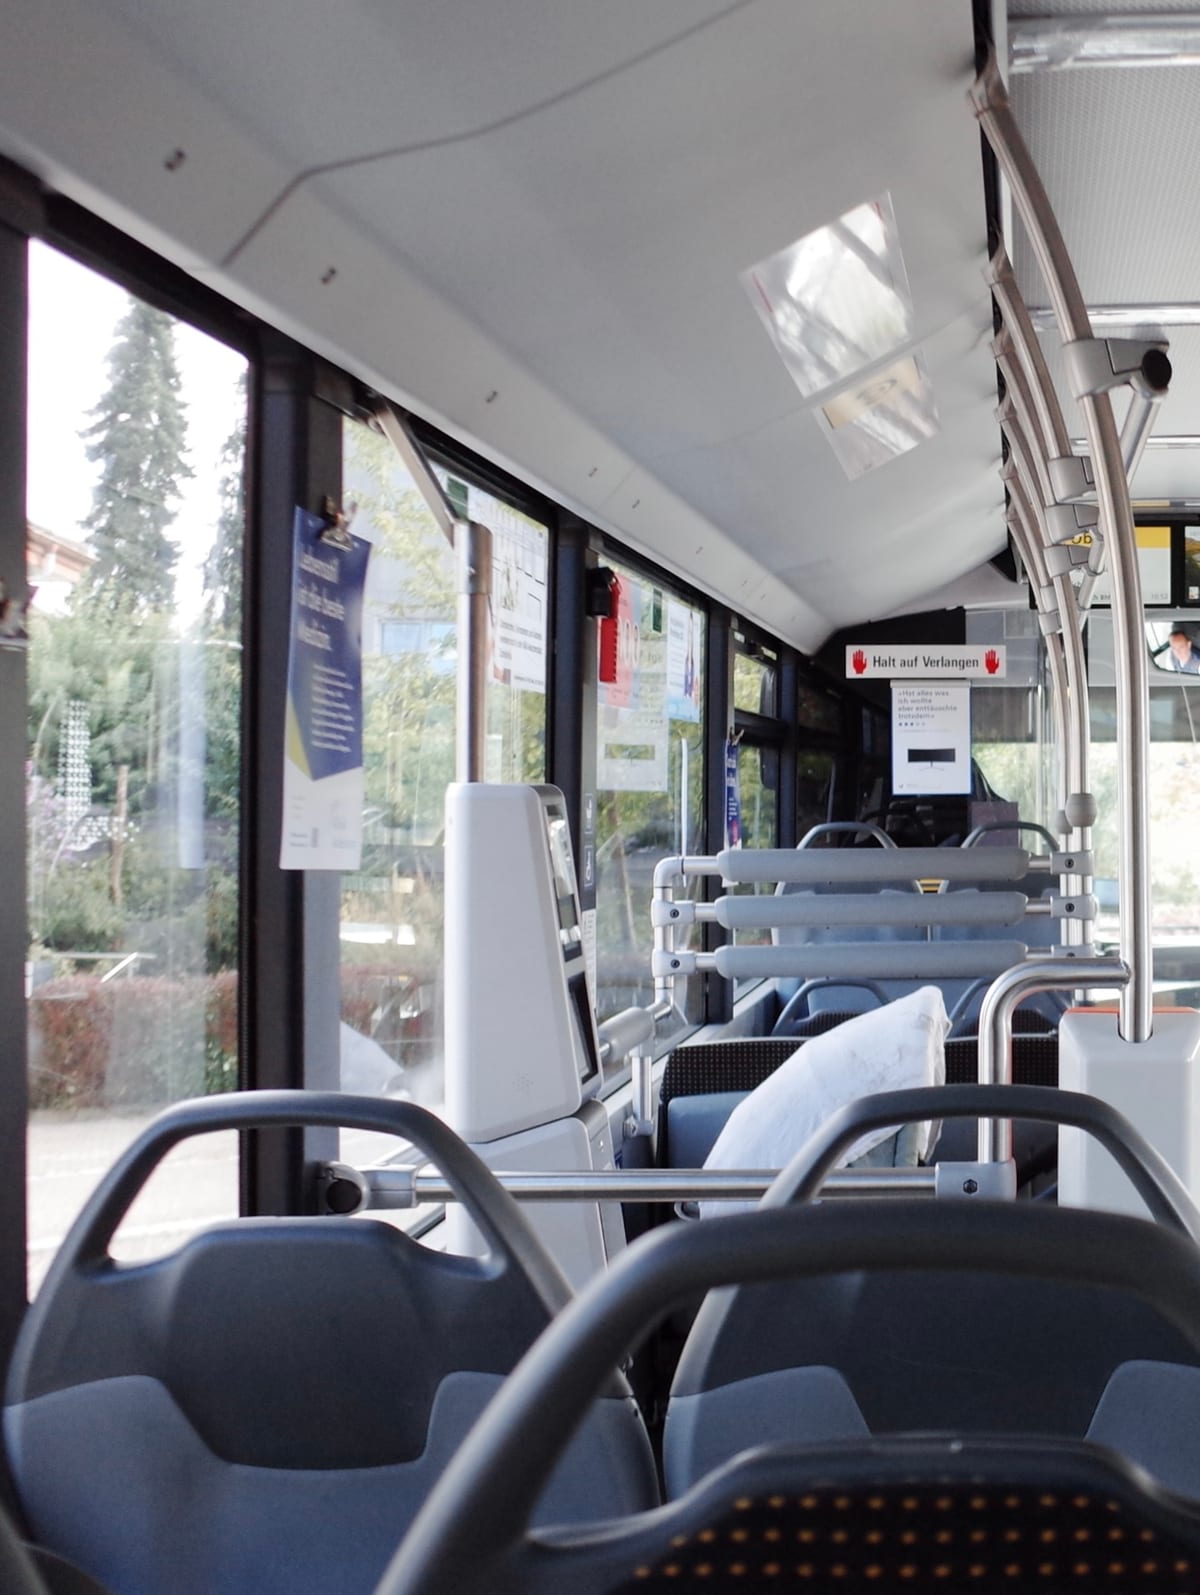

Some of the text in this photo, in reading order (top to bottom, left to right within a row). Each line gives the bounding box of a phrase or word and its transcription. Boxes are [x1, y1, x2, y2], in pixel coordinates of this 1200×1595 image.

[873, 656, 979, 670] Halt auf Verlangen
